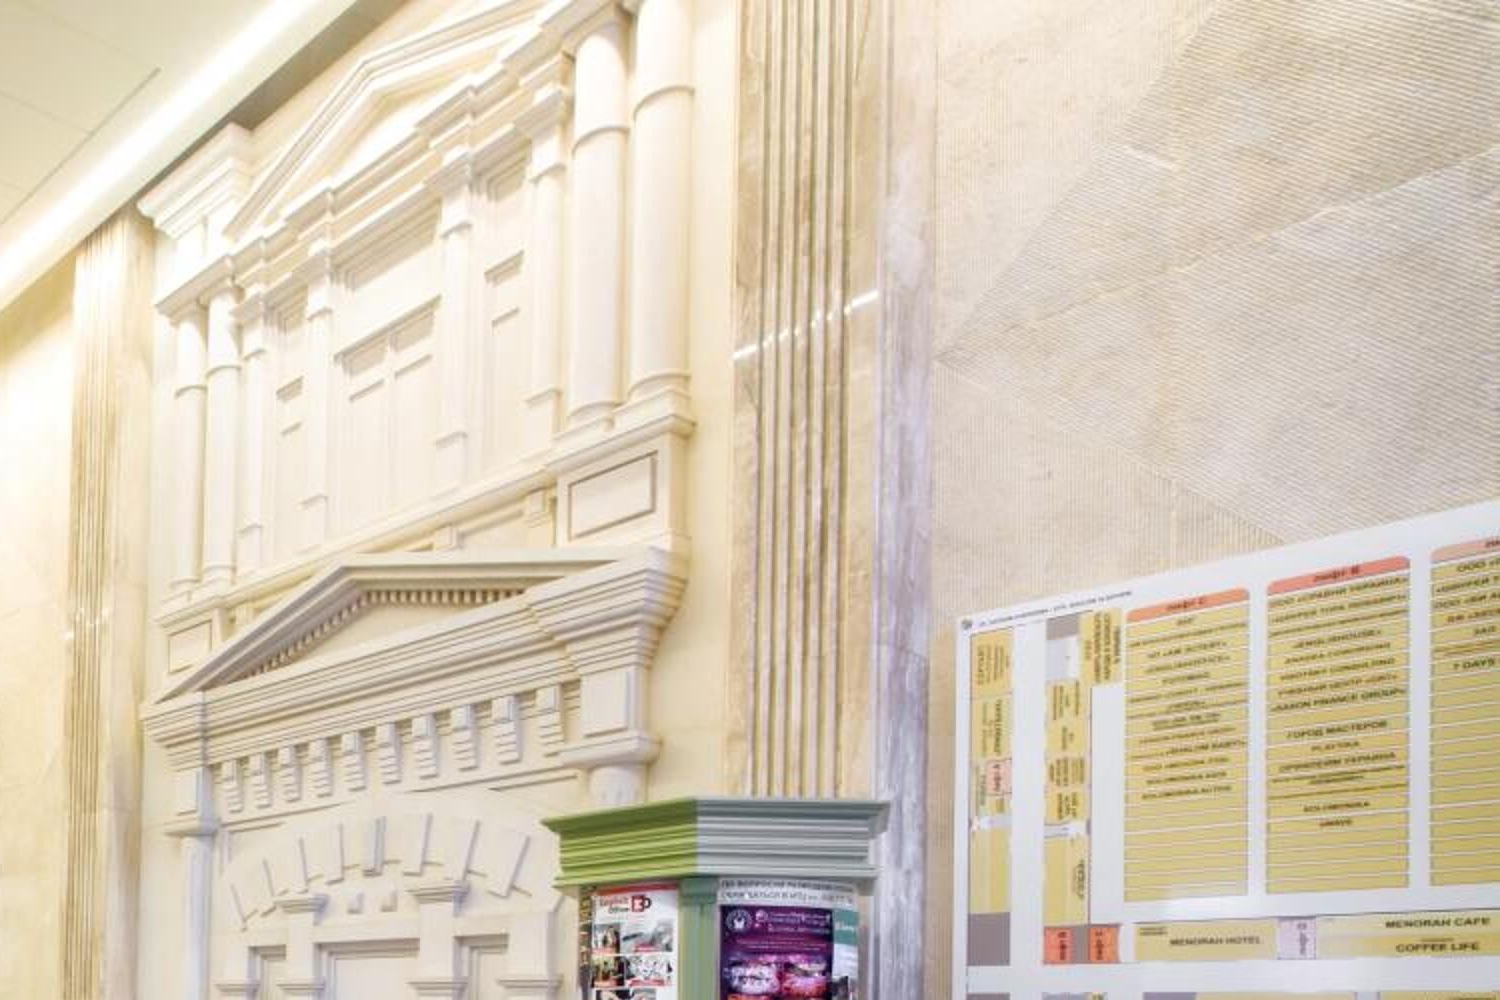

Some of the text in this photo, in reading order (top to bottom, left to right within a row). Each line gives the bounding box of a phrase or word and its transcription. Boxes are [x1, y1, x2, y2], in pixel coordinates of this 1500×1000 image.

[1385, 917, 1491, 928] MENORAH CAFE
[1169, 934, 1261, 946] MENORAH HOTEL
[1395, 941, 1480, 953] COFFEE LIFE
